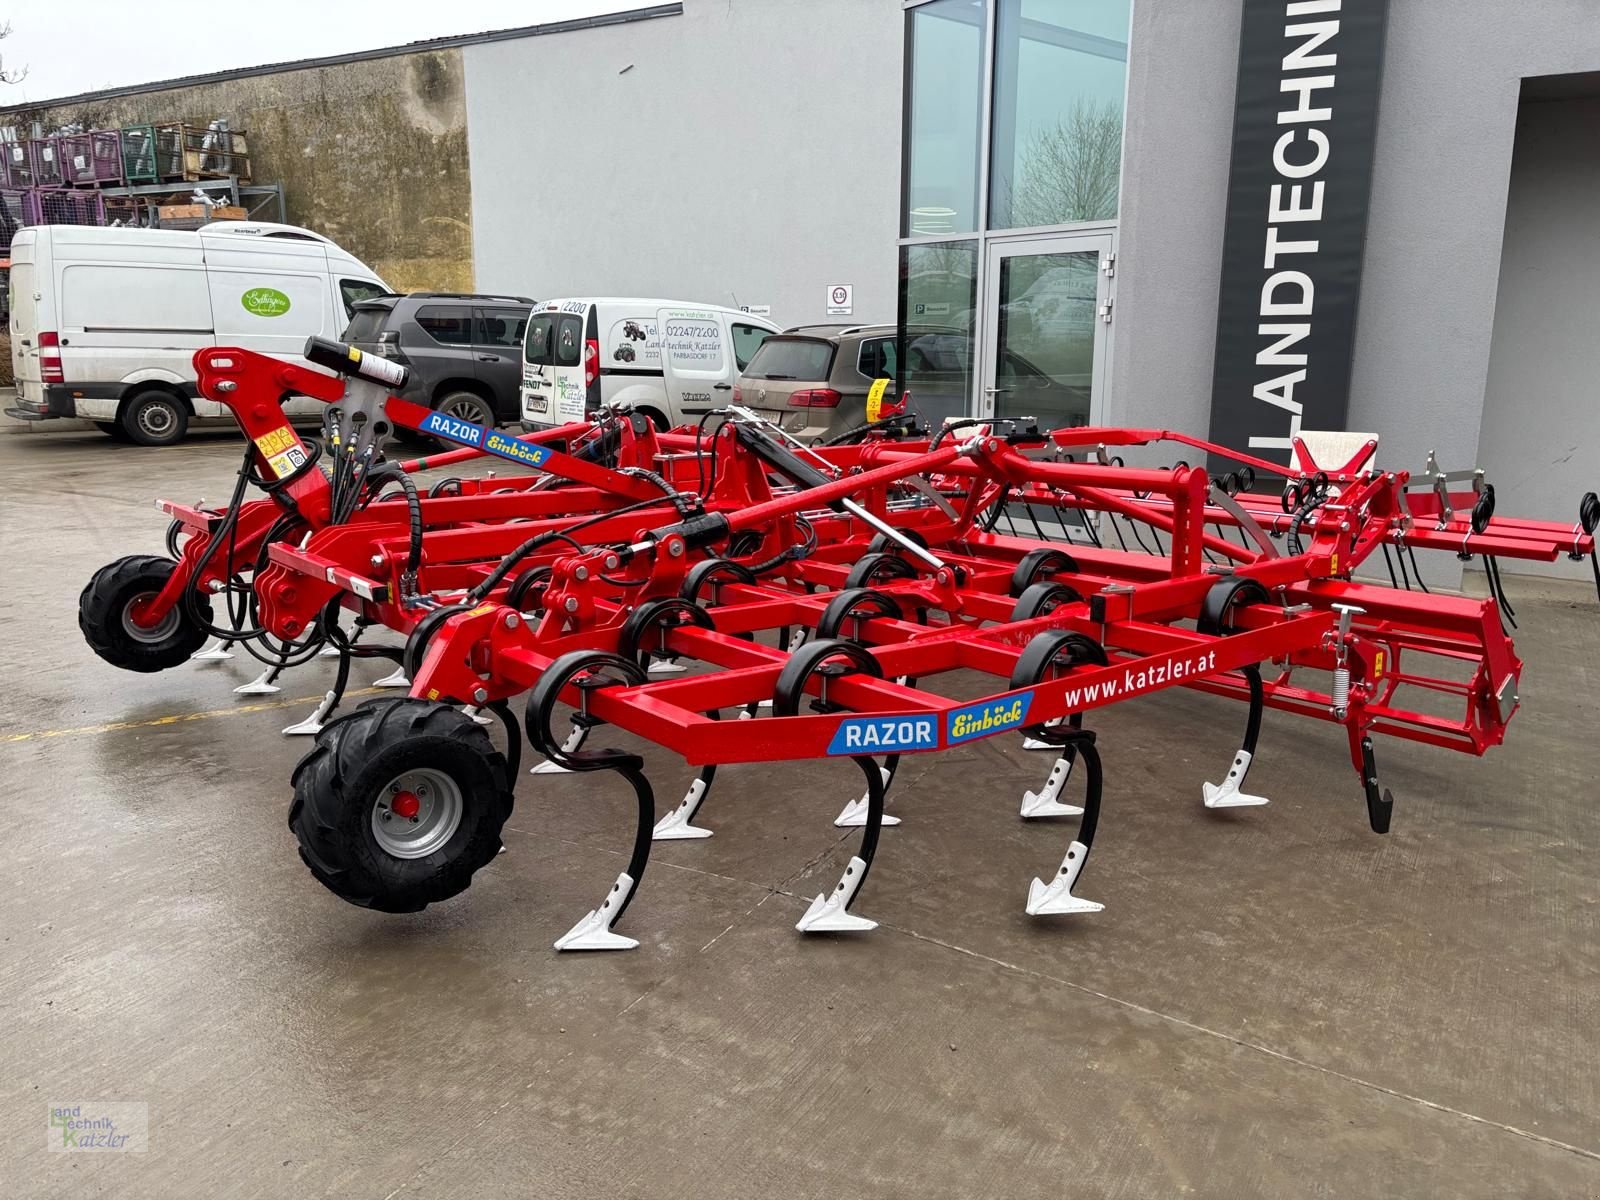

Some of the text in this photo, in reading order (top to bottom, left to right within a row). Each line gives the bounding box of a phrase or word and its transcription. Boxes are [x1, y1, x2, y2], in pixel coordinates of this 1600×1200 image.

[563, 301, 587, 314] 2200
[666, 325, 719, 338] 02247/2200
[430, 415, 542, 463] RAZOR Einböck
[846, 650, 1217, 747] RAZOR Einböck www.katzler.at
